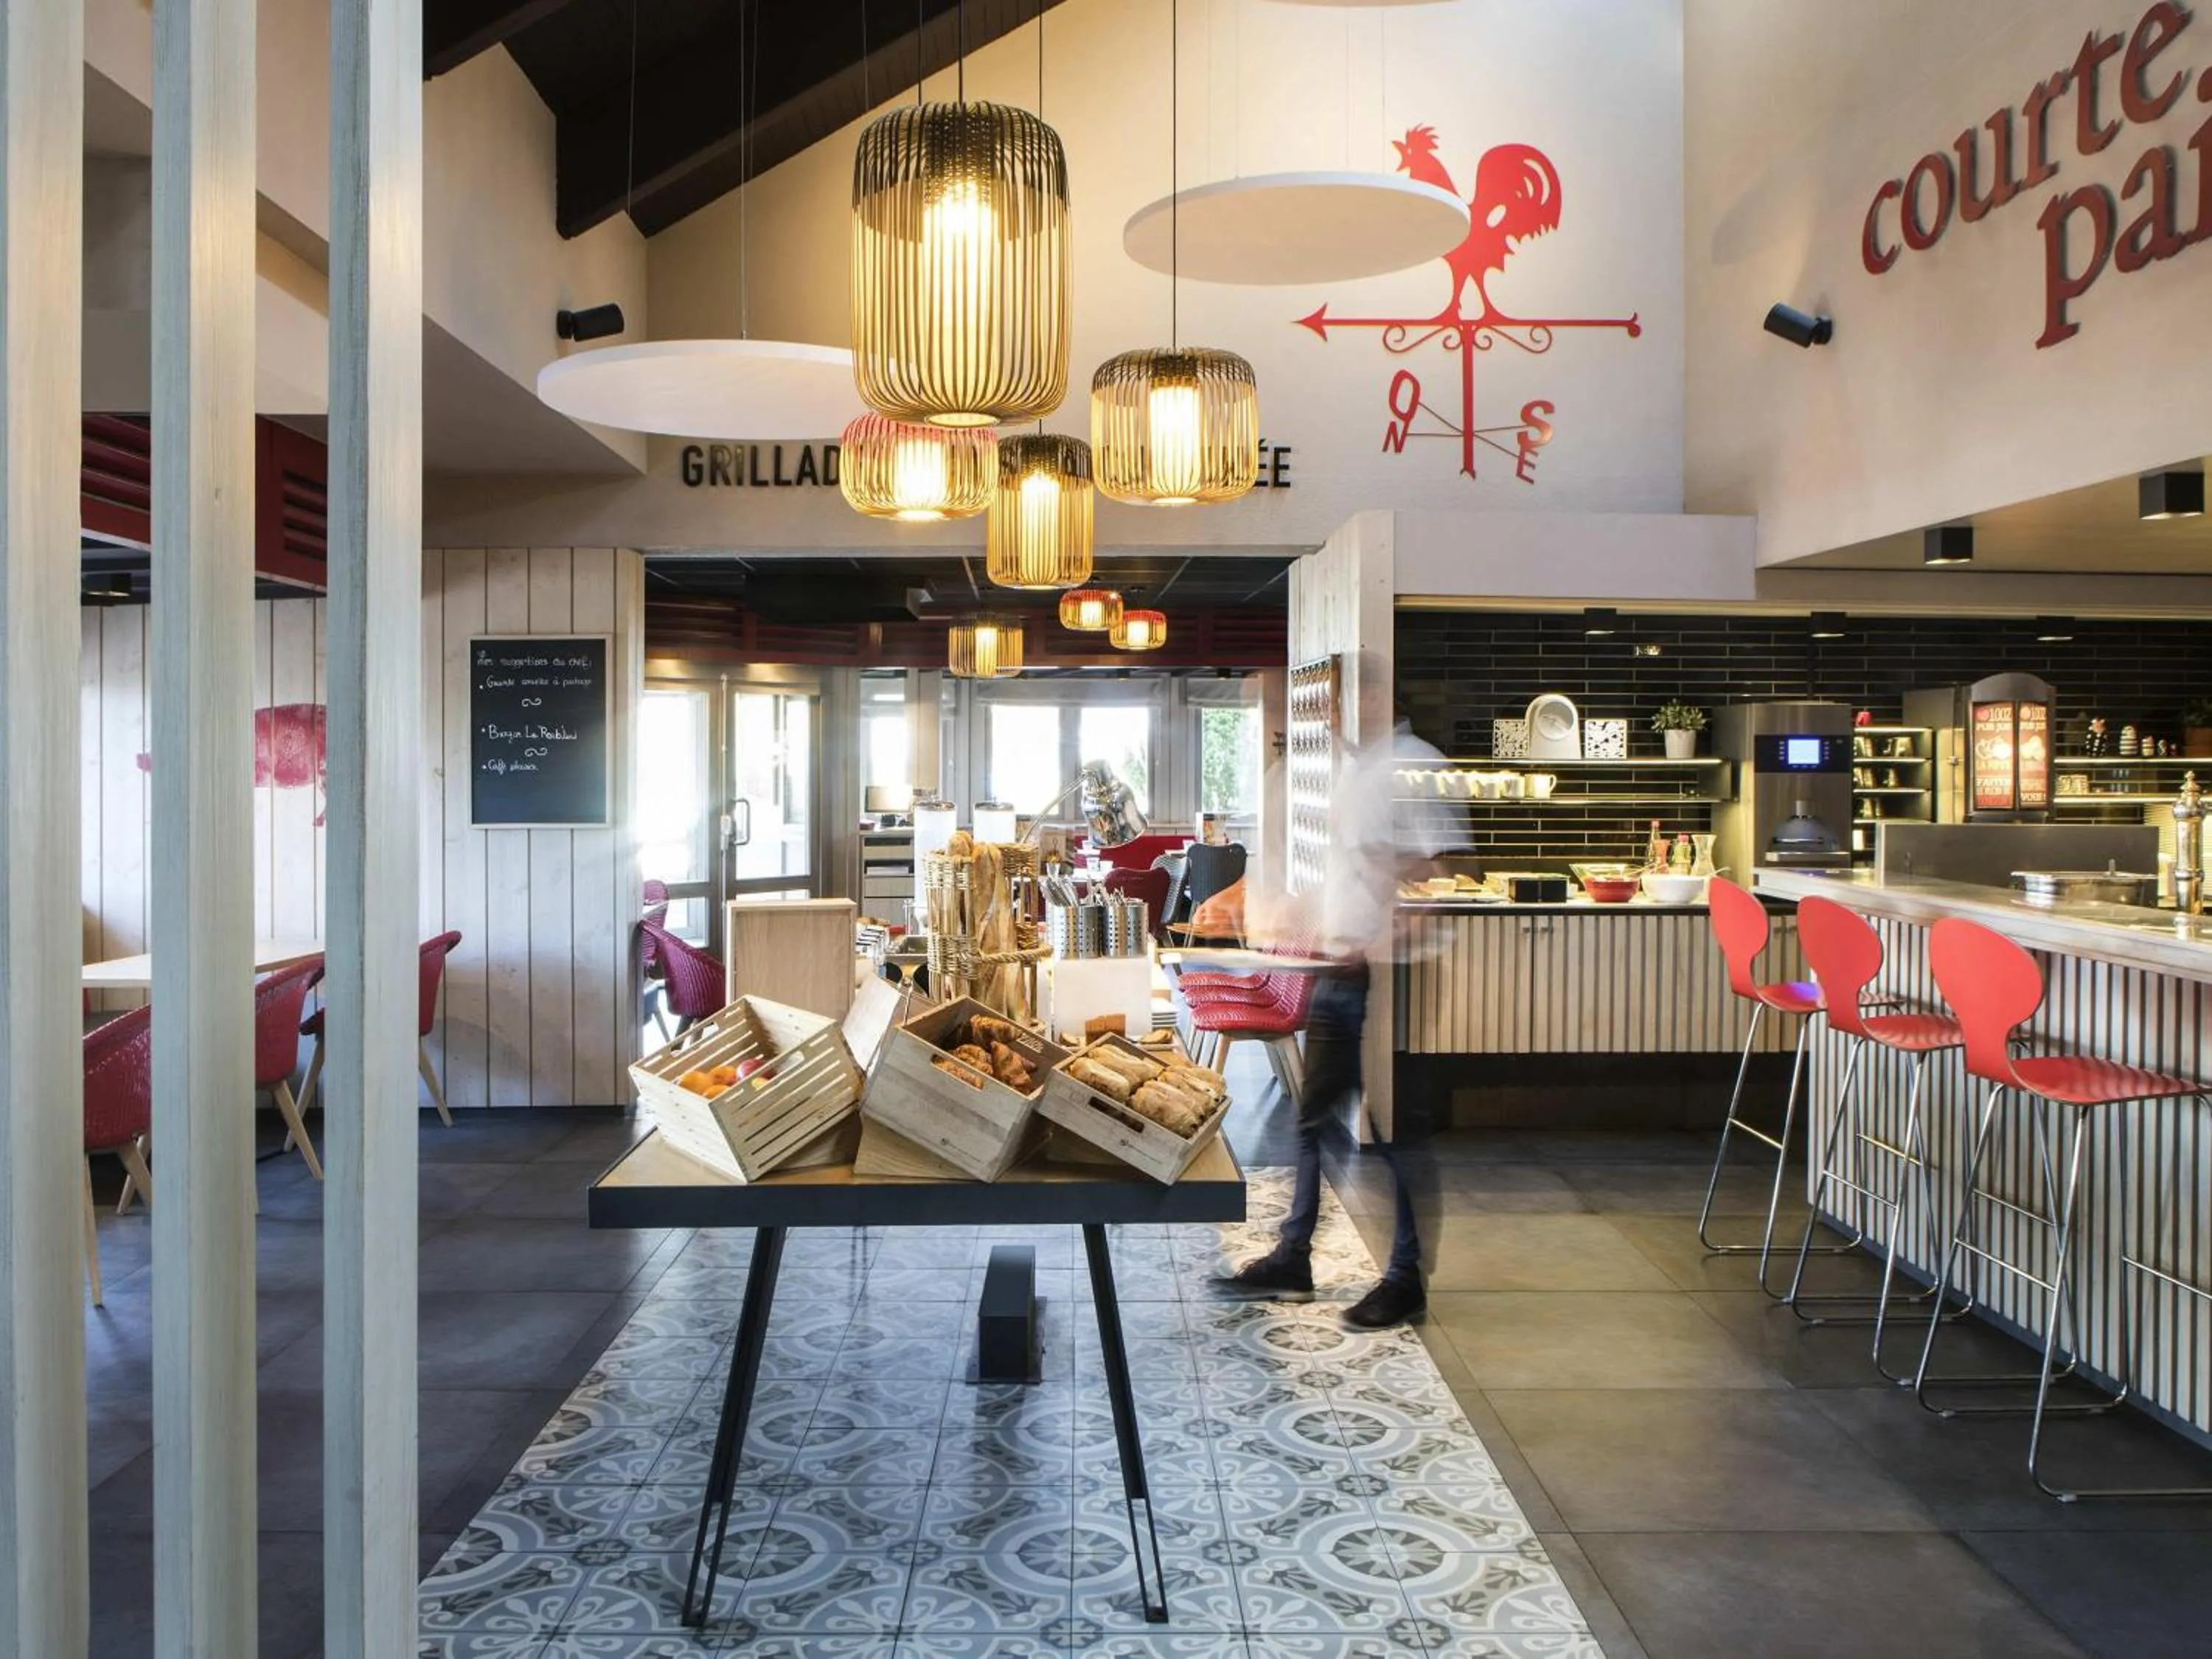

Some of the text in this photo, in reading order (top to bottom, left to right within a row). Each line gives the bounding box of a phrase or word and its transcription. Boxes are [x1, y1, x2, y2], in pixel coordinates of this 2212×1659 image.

[1863, 1, 2190, 276] courte
[1382, 420, 1410, 453] N
[1517, 400, 1556, 447] S
[682, 445, 842, 487] GRILLAD
[552, 676, 560, 686] à
